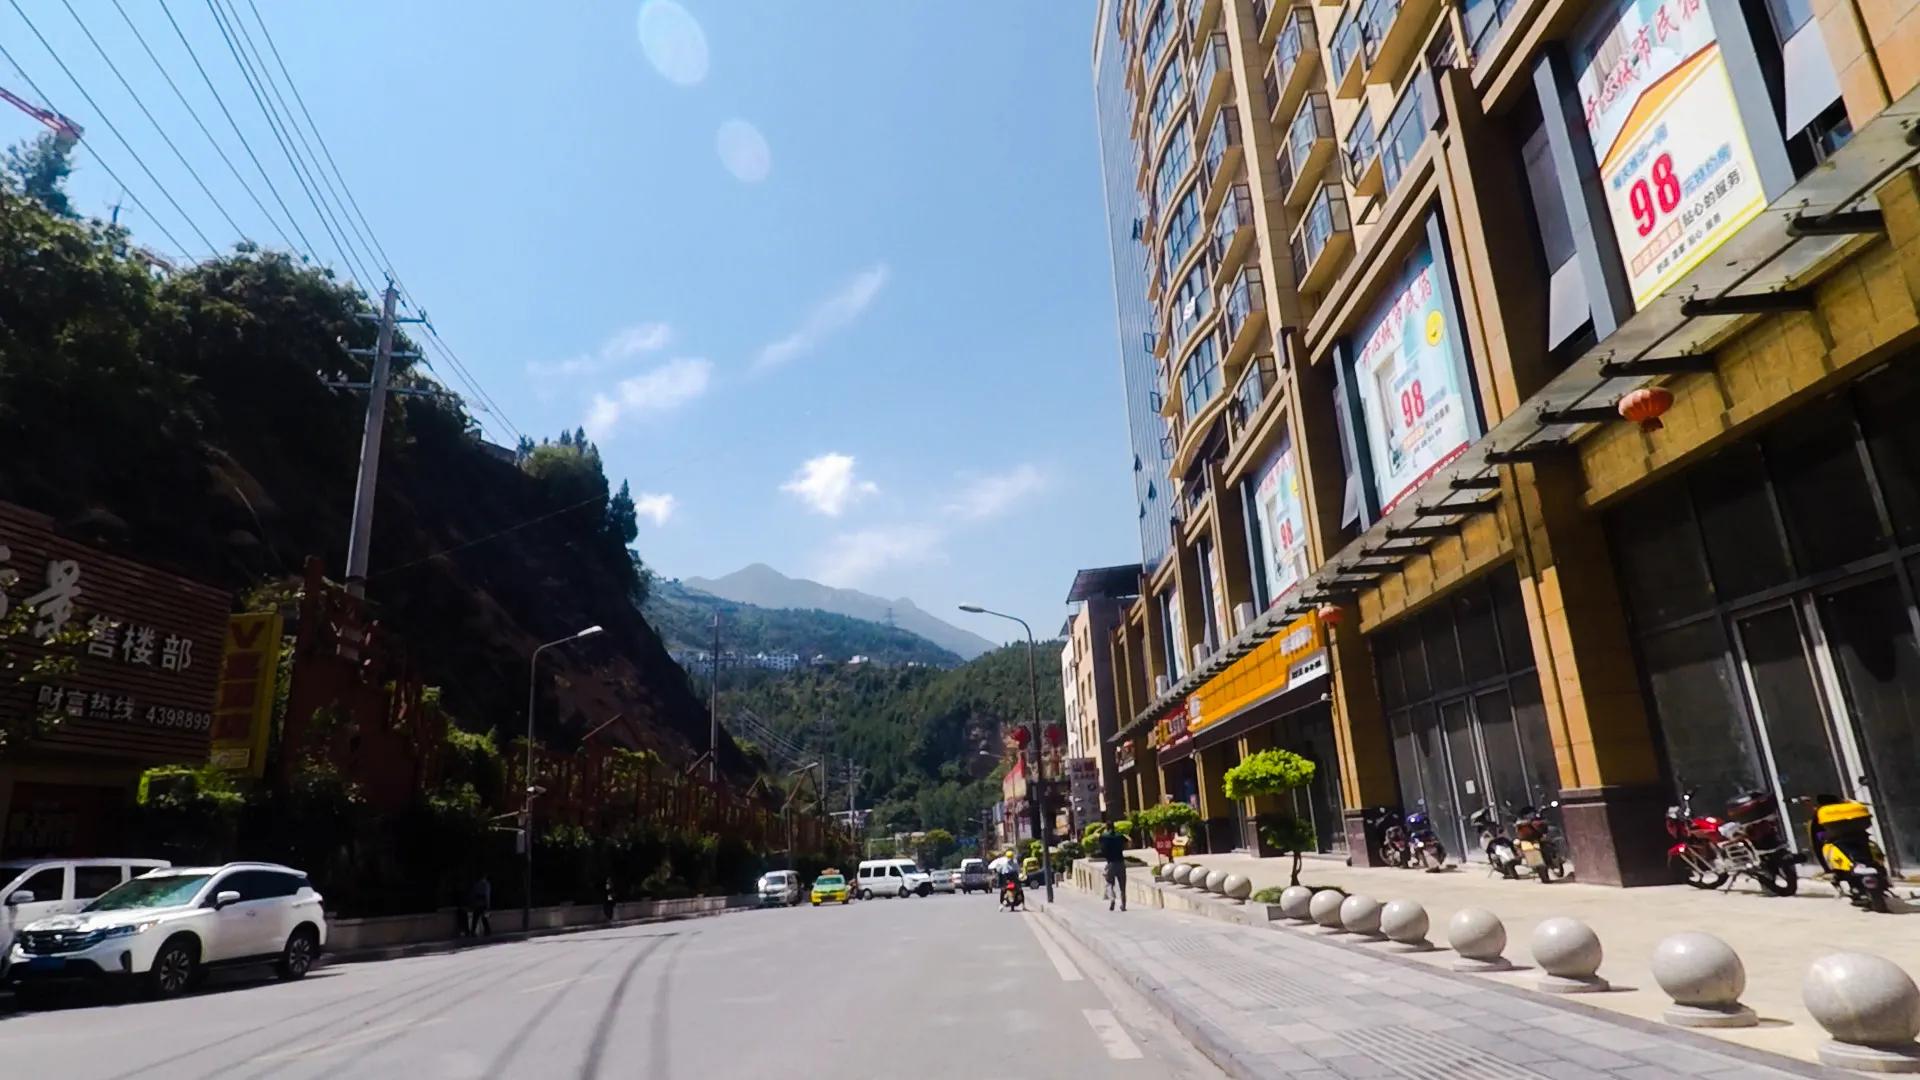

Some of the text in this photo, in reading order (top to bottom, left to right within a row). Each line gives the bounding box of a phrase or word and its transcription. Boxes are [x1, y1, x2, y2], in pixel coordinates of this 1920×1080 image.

[1629, 153, 1681, 238] 98
[1401, 380, 1425, 428] 98
[87, 614, 193, 672] 售楼部
[144, 706, 211, 731] 4398899
